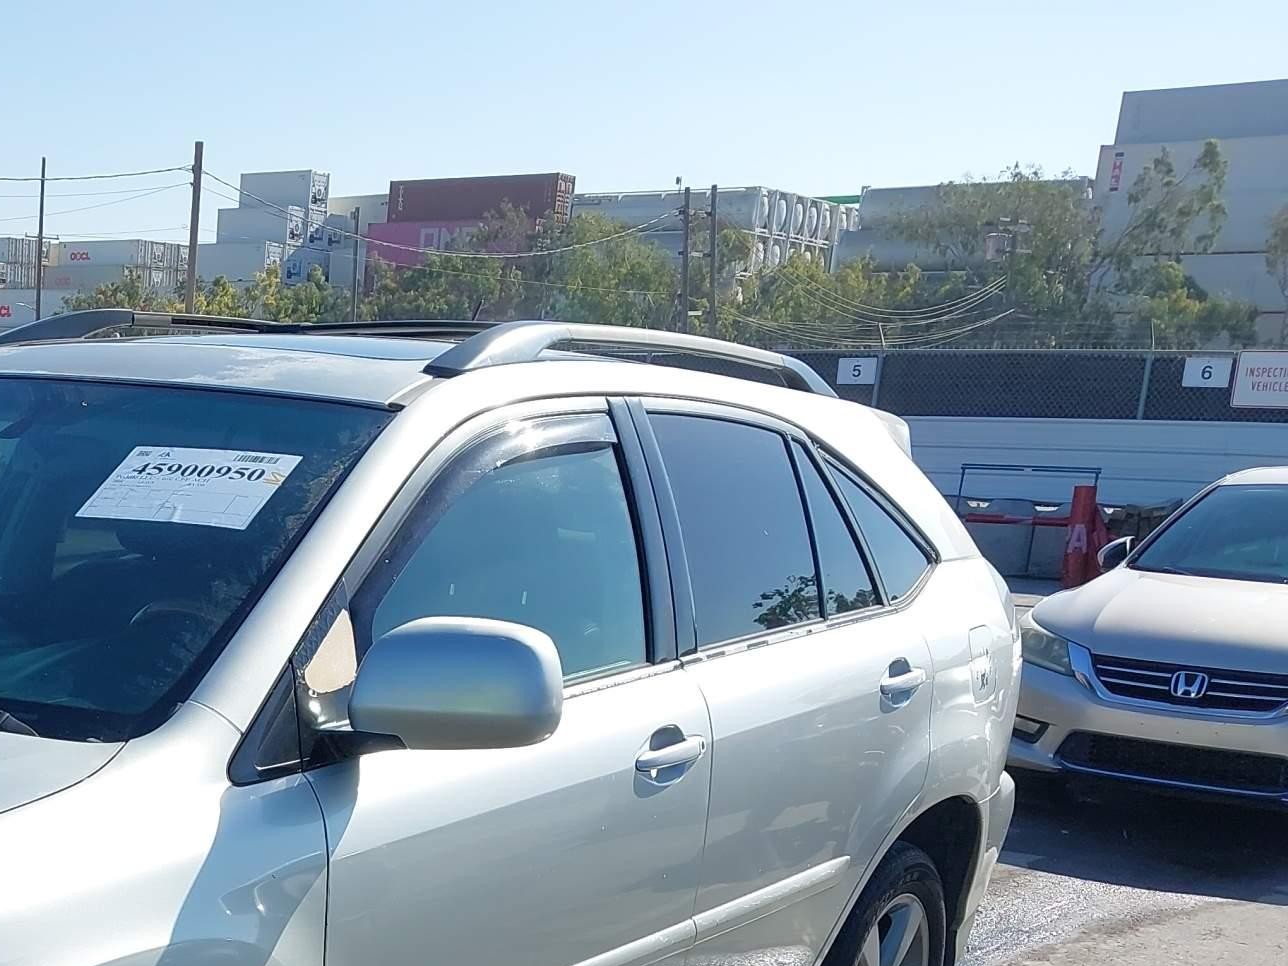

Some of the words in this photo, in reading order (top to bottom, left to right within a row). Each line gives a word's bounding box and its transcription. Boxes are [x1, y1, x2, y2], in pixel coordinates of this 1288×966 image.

[852, 364, 862, 378] 5
[1200, 365, 1213, 380] 6
[1245, 367, 1288, 378] INSPECTI
[132, 462, 266, 482] 45900950
